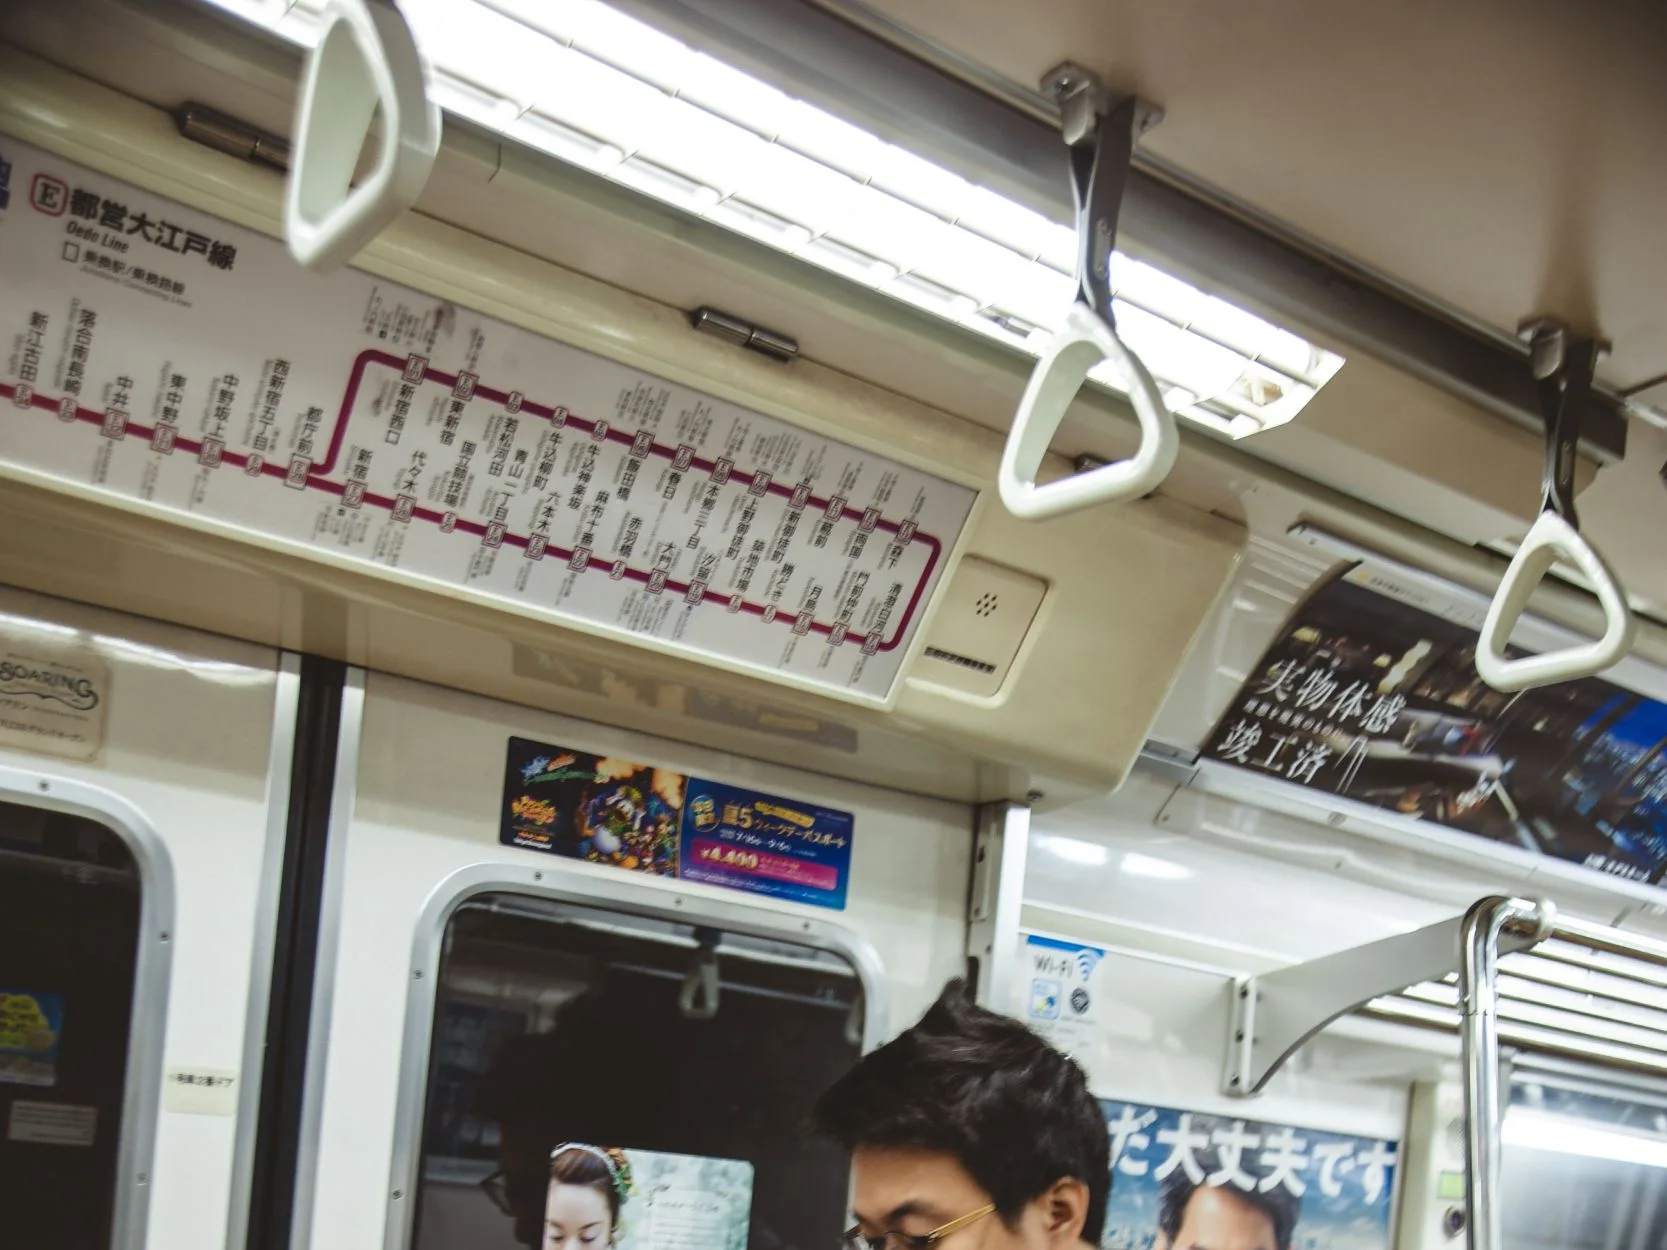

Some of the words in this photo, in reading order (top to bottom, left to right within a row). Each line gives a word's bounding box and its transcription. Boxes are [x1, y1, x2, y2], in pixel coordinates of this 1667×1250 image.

[37, 181, 61, 210] E
[66, 220, 101, 243] Oedo
[101, 234, 130, 254] Line
[70, 188, 238, 271] 都営大江戸線
[112, 374, 135, 407] 中井
[160, 373, 188, 424] 東中野
[208, 372, 240, 438] 中野坂上
[296, 405, 324, 455] 都庁前
[384, 384, 416, 446] 新宿西口
[439, 400, 466, 447] 東新宿
[352, 448, 375, 480] 新宿
[402, 449, 428, 493] 代々木
[494, 448, 528, 521] 青山一丁目
[663, 471, 682, 500] 春日
[536, 490, 562, 533] 六本木
[580, 490, 610, 547] 麻布十番
[656, 541, 677, 570] 大門
[887, 545, 905, 571] 森下
[1255, 657, 1407, 735] 実物体感
[1108, 1103, 1397, 1206] だ大丈夫です
